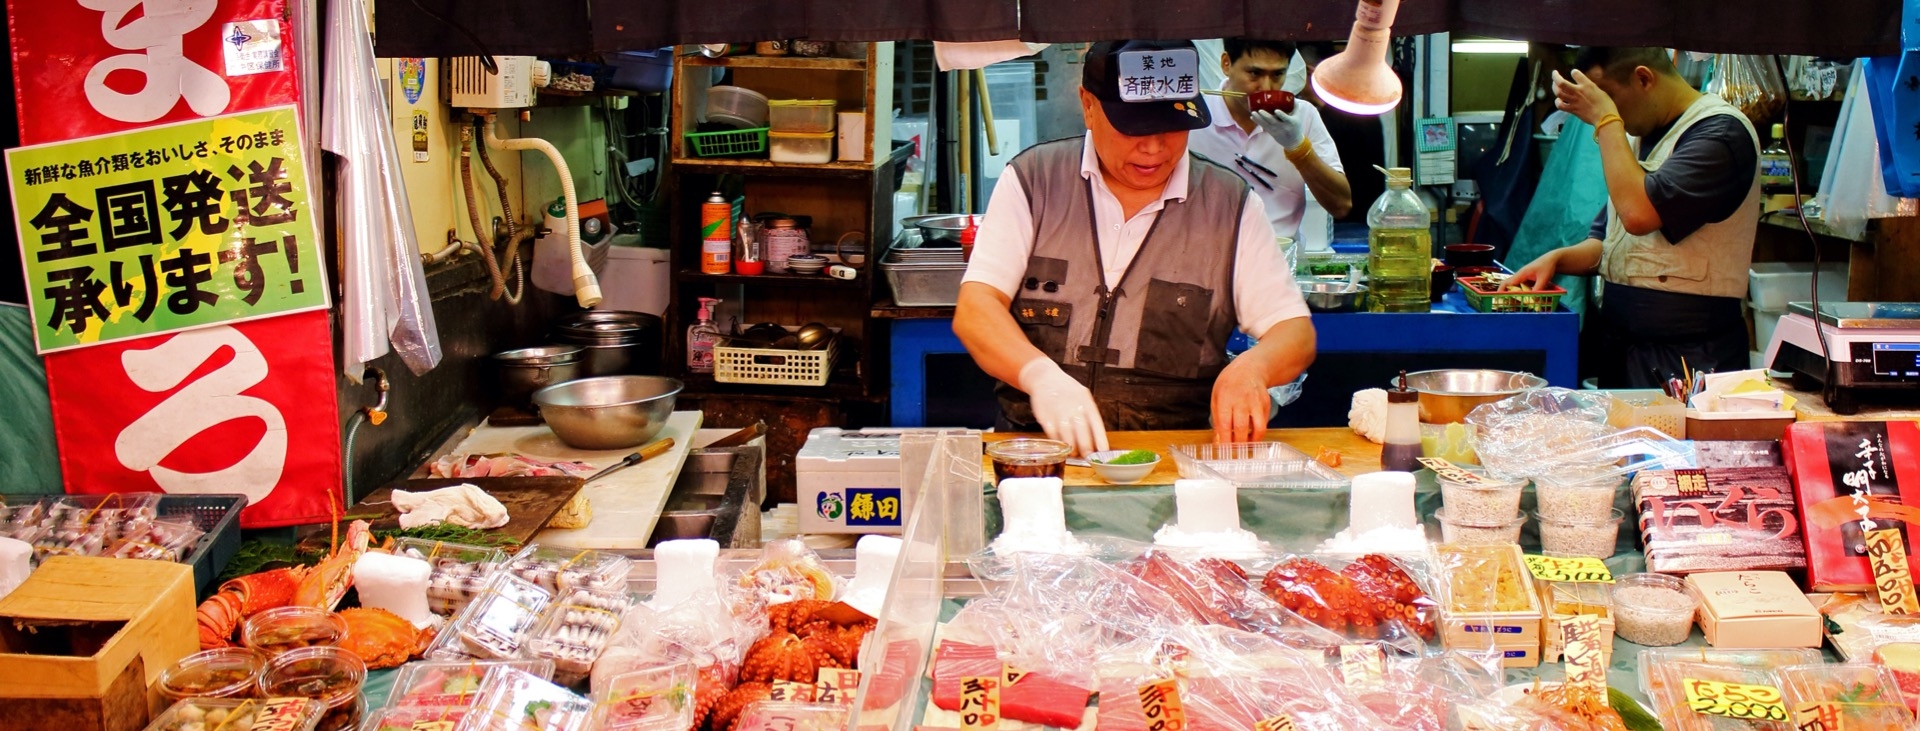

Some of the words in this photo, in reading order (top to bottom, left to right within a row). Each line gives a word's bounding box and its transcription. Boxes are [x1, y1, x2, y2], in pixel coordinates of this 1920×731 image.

[1142, 55, 1176, 71] 築地
[1123, 73, 1194, 95] 斉藤水産
[24, 128, 285, 187] 新鮮な魚介類をおいしさ、そのまま
[29, 156, 298, 263] 全国発送
[1678, 474, 1708, 492] 網走
[850, 492, 899, 521] 鎌田
[1647, 485, 1798, 541] いくら
